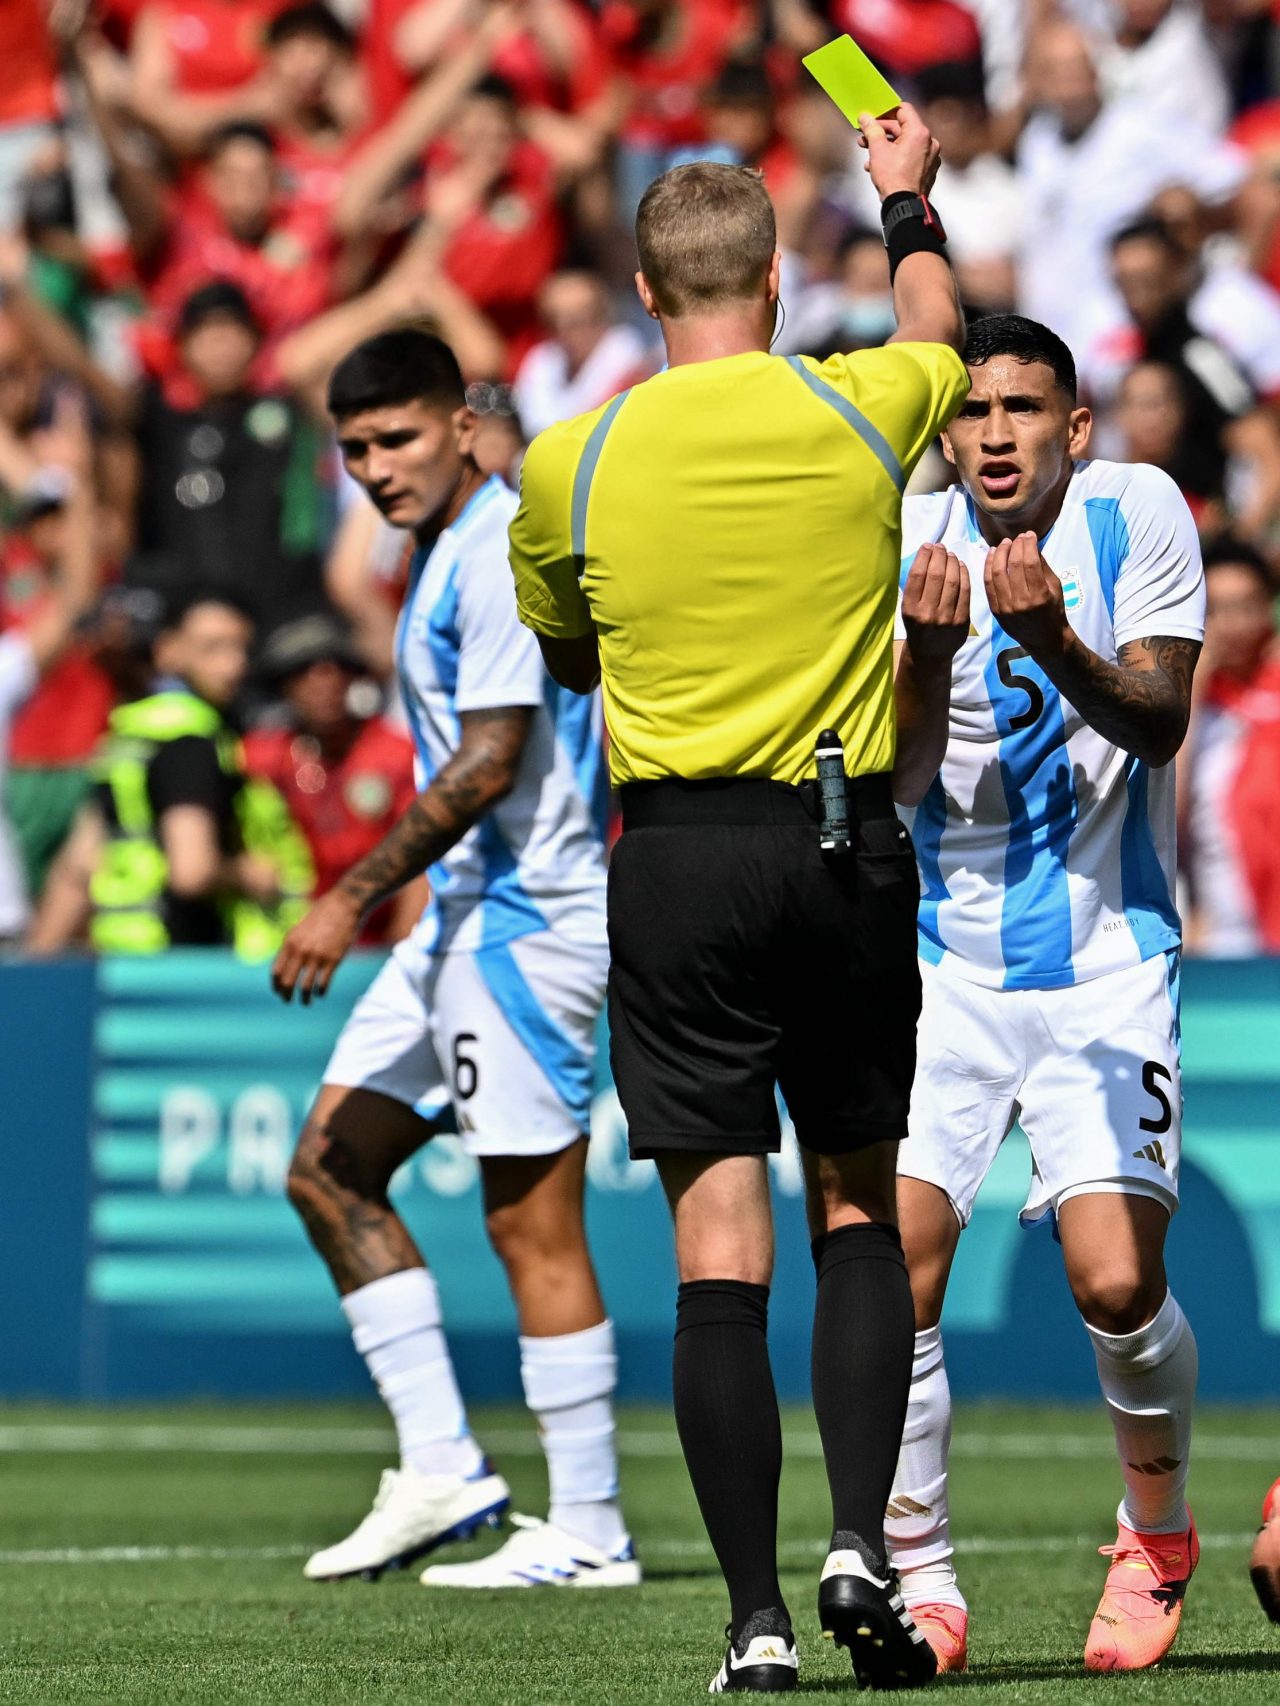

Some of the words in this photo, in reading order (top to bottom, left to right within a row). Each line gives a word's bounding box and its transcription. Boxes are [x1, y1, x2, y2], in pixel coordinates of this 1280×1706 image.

[996, 646, 1044, 730] 5
[453, 1032, 478, 1101] 6
[1139, 1060, 1172, 1134] 5
